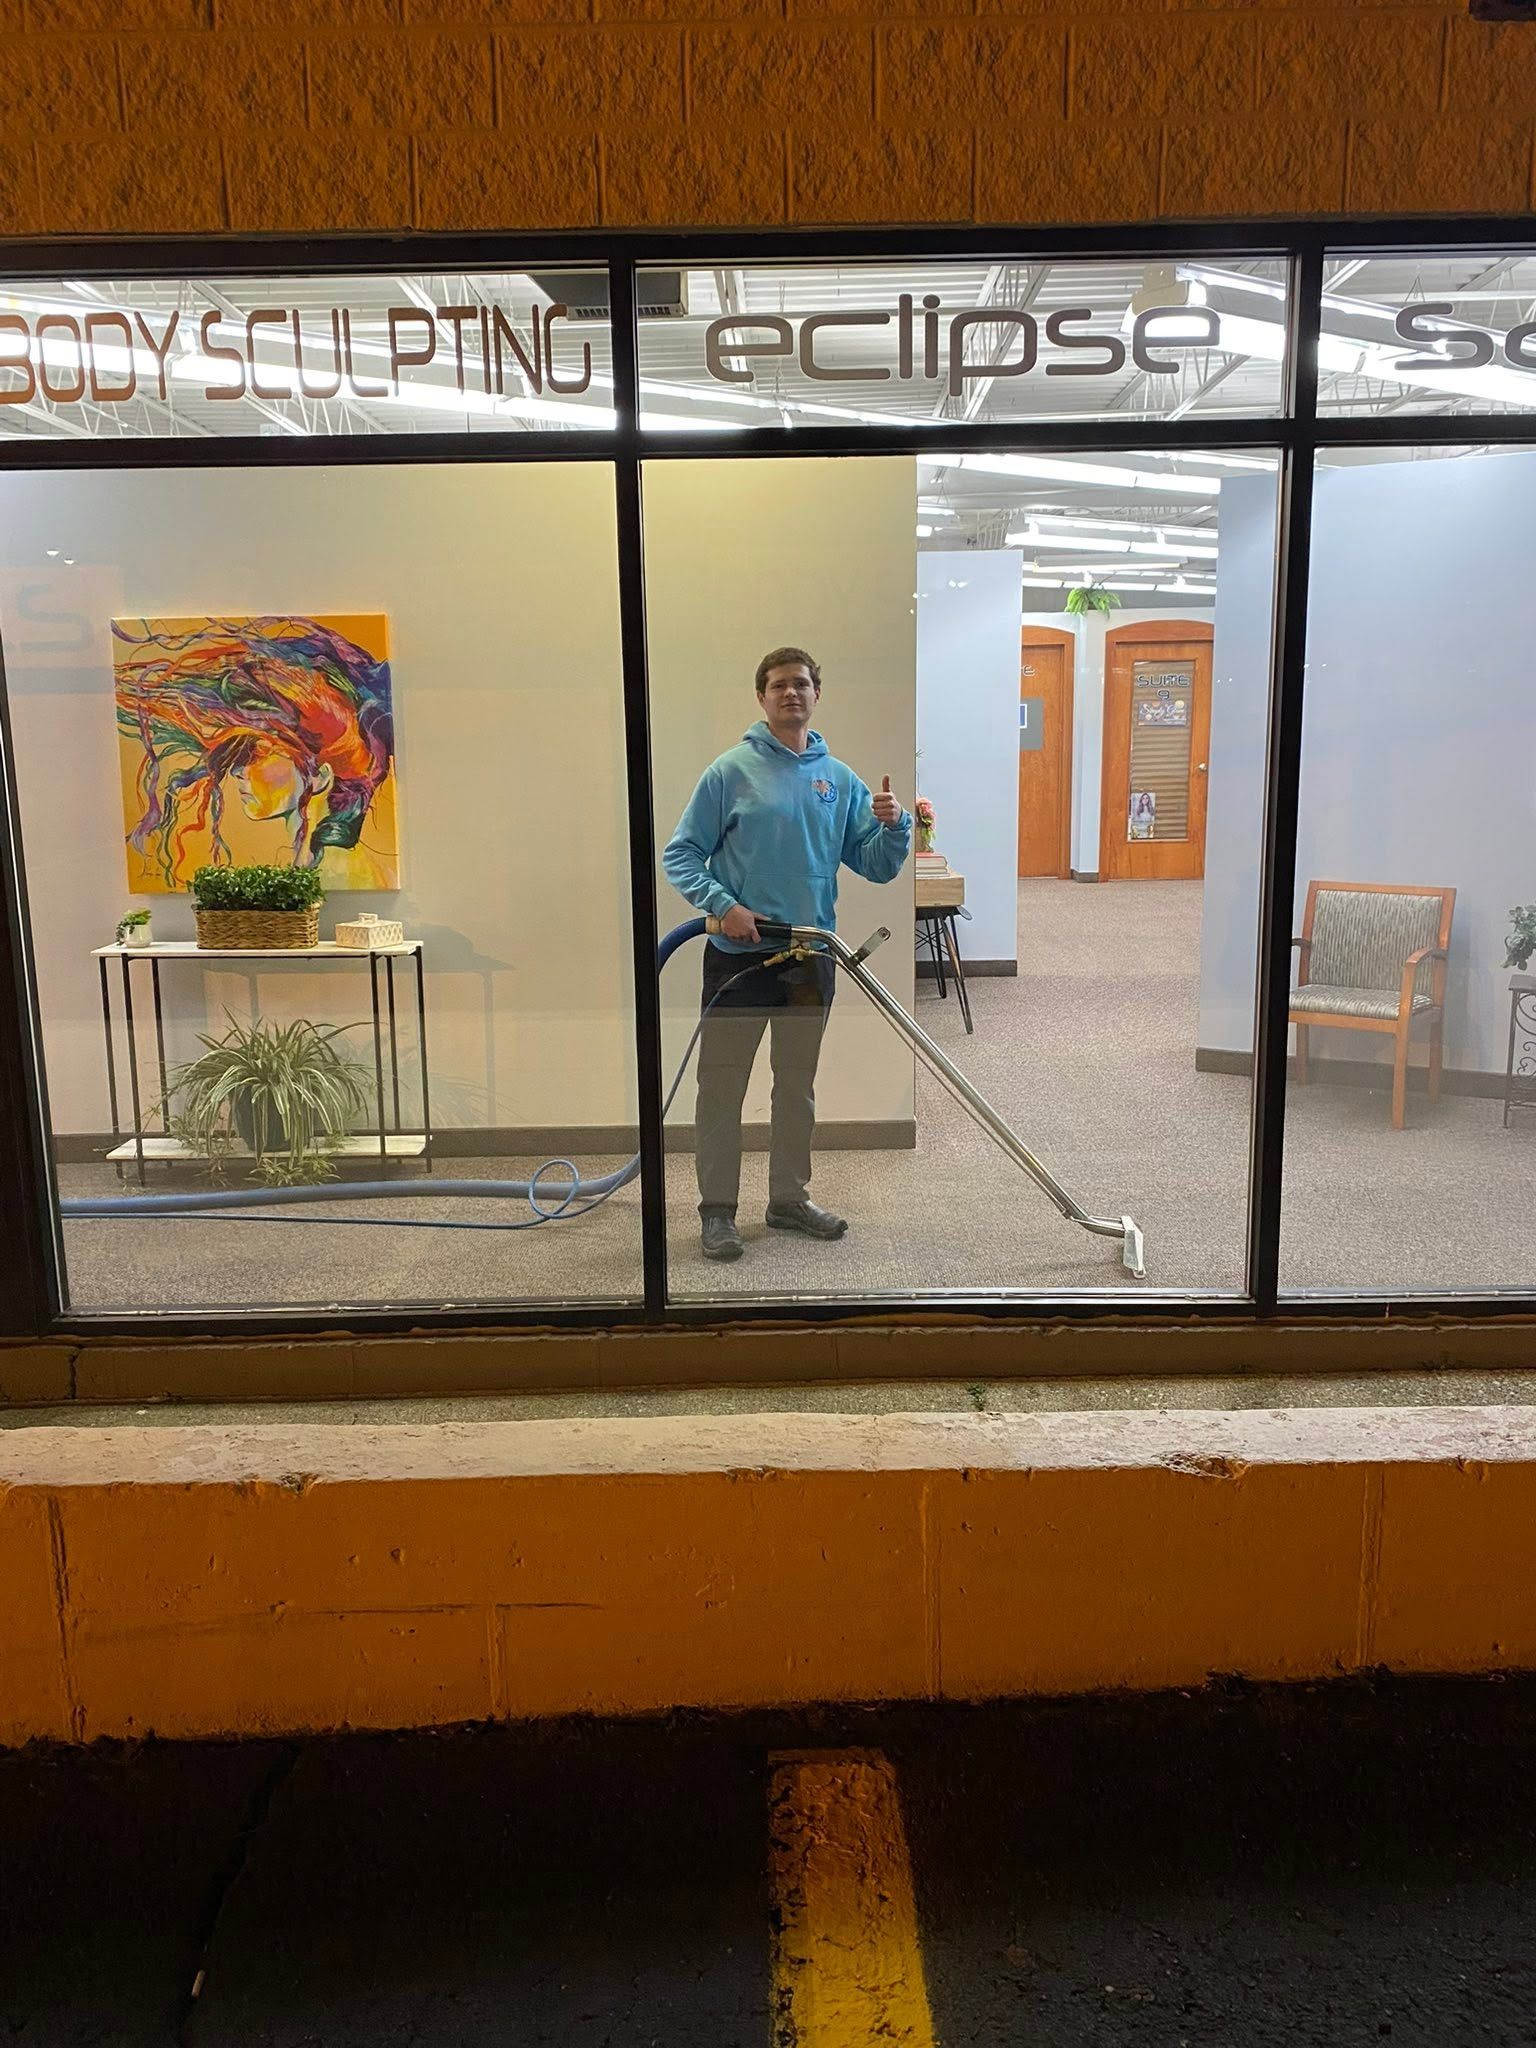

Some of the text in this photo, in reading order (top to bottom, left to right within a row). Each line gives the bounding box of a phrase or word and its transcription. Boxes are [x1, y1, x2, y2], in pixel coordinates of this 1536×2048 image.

[0, 303, 591, 404] BODY SCULPTING
[705, 293, 1220, 396] eclipse
[1138, 674, 1190, 687] SUITE
